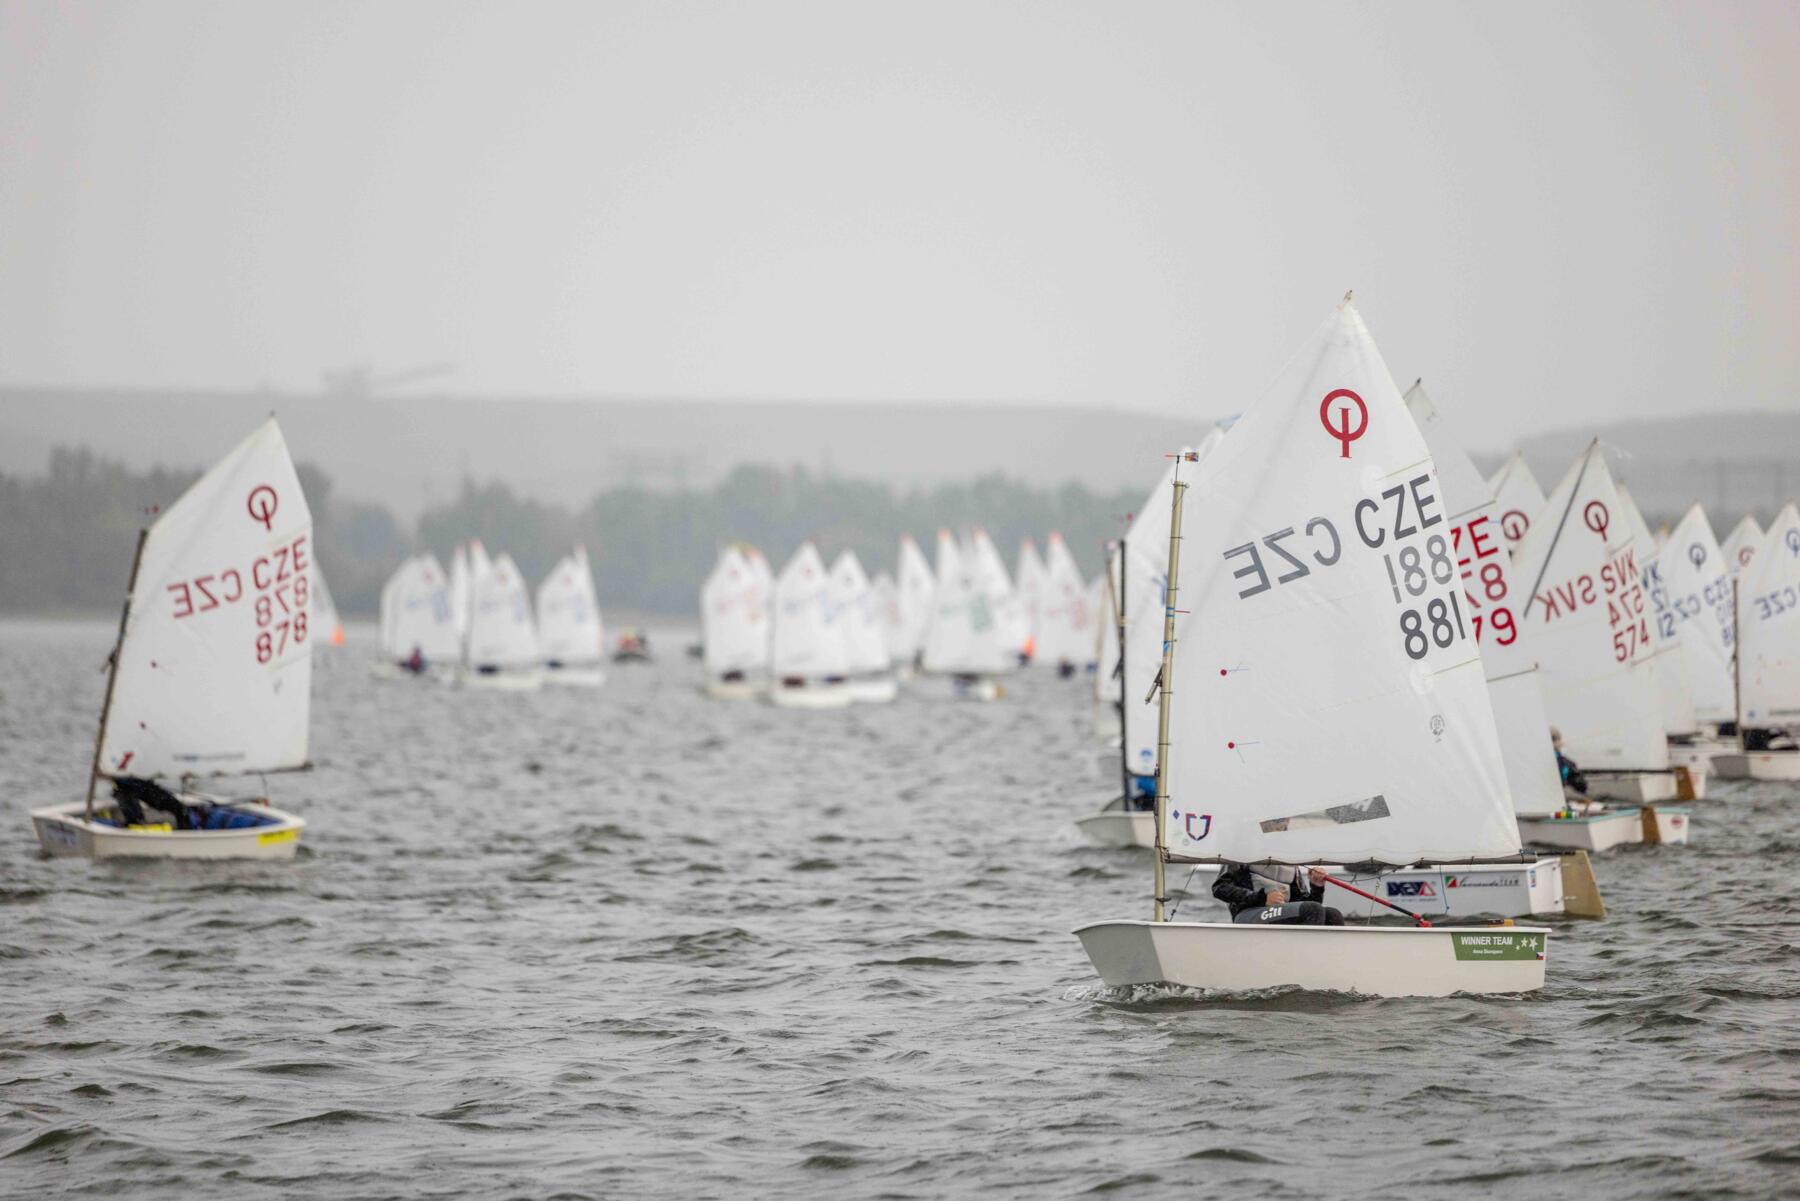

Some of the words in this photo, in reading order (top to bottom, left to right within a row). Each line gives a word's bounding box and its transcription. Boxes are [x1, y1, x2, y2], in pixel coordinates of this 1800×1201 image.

[1354, 473, 1442, 549] CZE
[252, 536, 308, 590] CZE
[1601, 549, 1638, 594] SVK
[256, 611, 308, 664] 878
[1399, 591, 1466, 660] 881
[1614, 618, 1649, 662] 574
[1260, 907, 1282, 921] Gill
[1460, 936, 1491, 946] WINNER
[1492, 936, 1513, 946] TEAM
